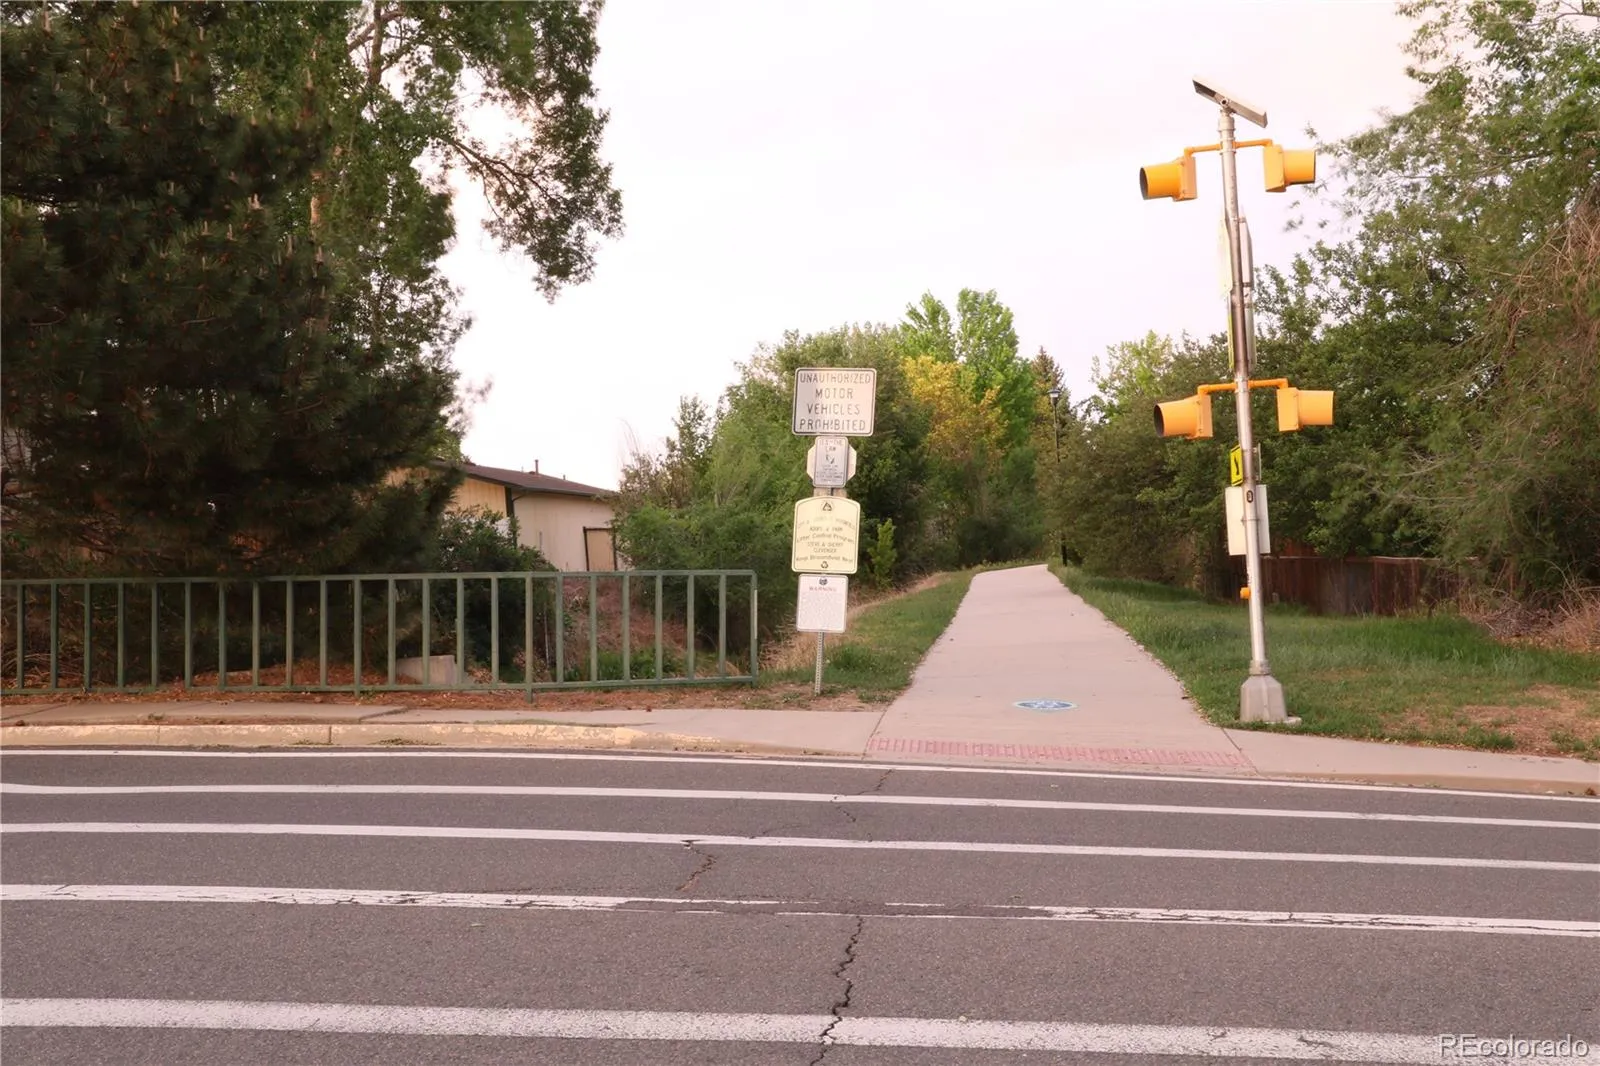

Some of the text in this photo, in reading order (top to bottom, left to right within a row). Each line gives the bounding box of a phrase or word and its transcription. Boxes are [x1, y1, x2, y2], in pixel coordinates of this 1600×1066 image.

[800, 373, 871, 384] UNAUTHORIZED
[815, 387, 854, 399] MOTOR
[807, 403, 861, 415] VEHICLES
[800, 419, 866, 431] PROHIBITED
